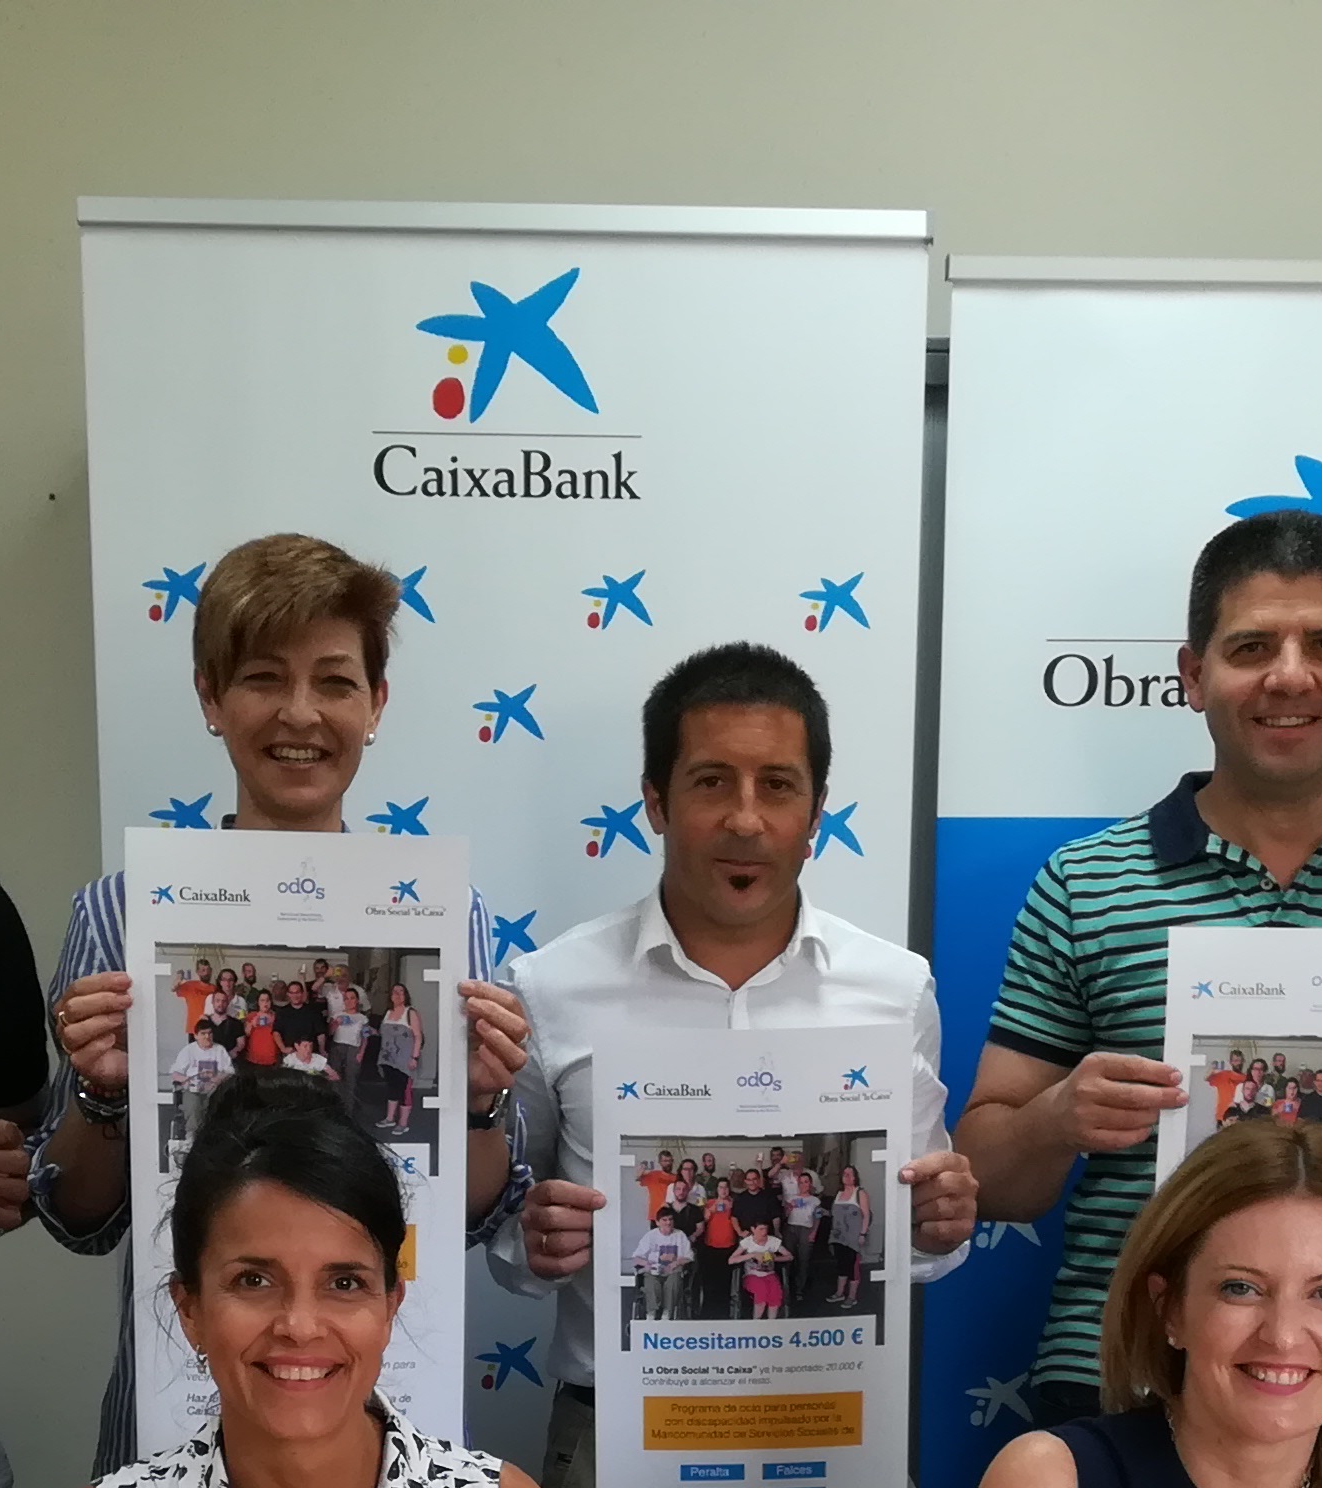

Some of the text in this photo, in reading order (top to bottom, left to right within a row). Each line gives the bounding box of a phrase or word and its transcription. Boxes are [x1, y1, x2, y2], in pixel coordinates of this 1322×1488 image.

[373, 444, 641, 500] CaixaBank
[1042, 654, 1188, 708] Obra
[179, 886, 251, 903] CaixaBank
[1219, 982, 1286, 996] CaixaBank
[643, 1082, 712, 1097] CaixaBank
[644, 1327, 862, 1349] Necesitamos 4.500 €
[691, 1466, 729, 1476] Peralta
[777, 1464, 812, 1475] Falces
